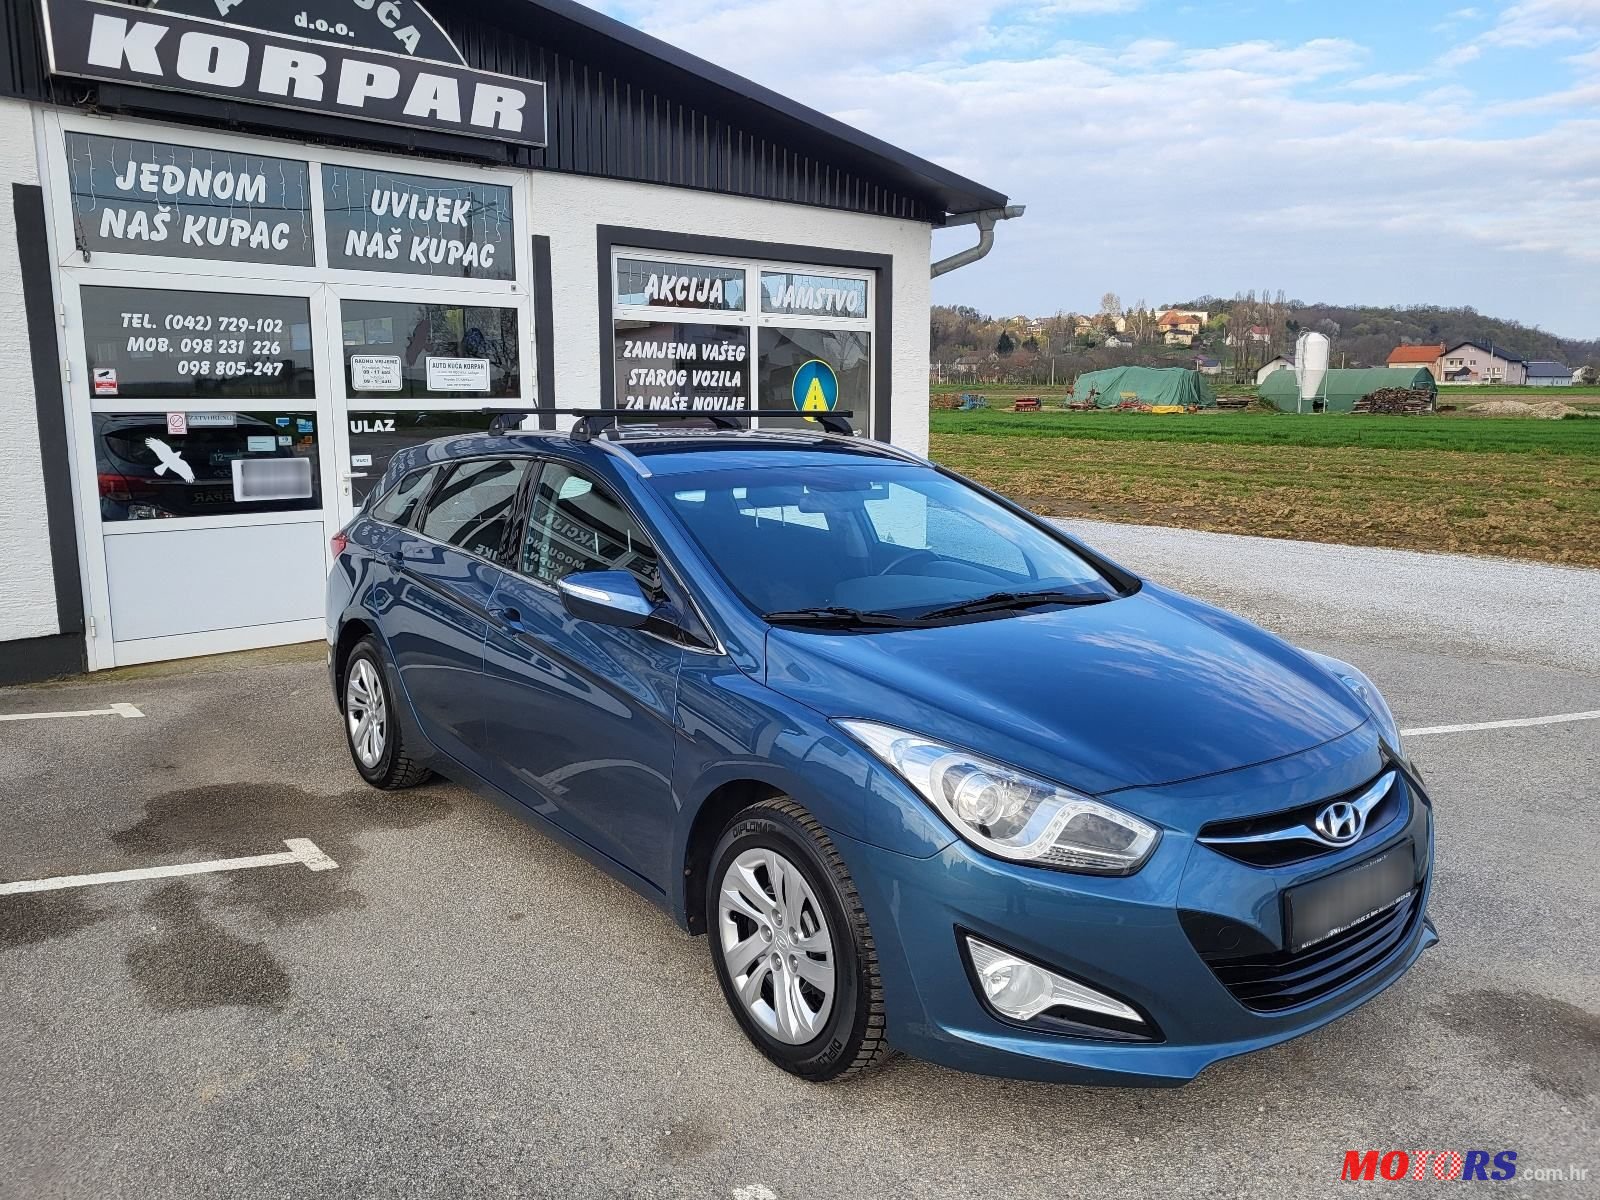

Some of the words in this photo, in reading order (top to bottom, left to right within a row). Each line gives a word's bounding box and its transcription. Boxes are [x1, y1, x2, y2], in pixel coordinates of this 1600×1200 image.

[294, 11, 355, 38] d.o.o.
[87, 13, 527, 133] KORPAR
[115, 160, 266, 204] JEDNOM
[370, 189, 472, 228] UVIJEK
[99, 205, 172, 242] NAŠ
[182, 214, 290, 251] KUPAC
[344, 227, 402, 260] NAŠ
[409, 235, 495, 269] KUPAC
[644, 273, 724, 304] AKCIJA
[771, 283, 859, 313] JAMSTVO
[120, 312, 157, 329] TEL.
[164, 314, 212, 331] (042)
[218, 316, 283, 333] 729-102
[126, 336, 174, 353] MOB.
[180, 338, 213, 354] 098
[218, 339, 245, 355] 231
[252, 340, 281, 355] 226
[622, 340, 697, 361] ZAMJENA
[701, 340, 746, 362] VAŠEG
[177, 360, 211, 376] 098
[215, 361, 284, 377] 805-247
[628, 368, 688, 388] STAROG
[692, 369, 741, 388] VOZILA
[624, 396, 645, 410] ZA
[649, 391, 689, 411] NAŠE
[692, 396, 746, 411] NOVIJE
[350, 419, 396, 434] ULAZ
